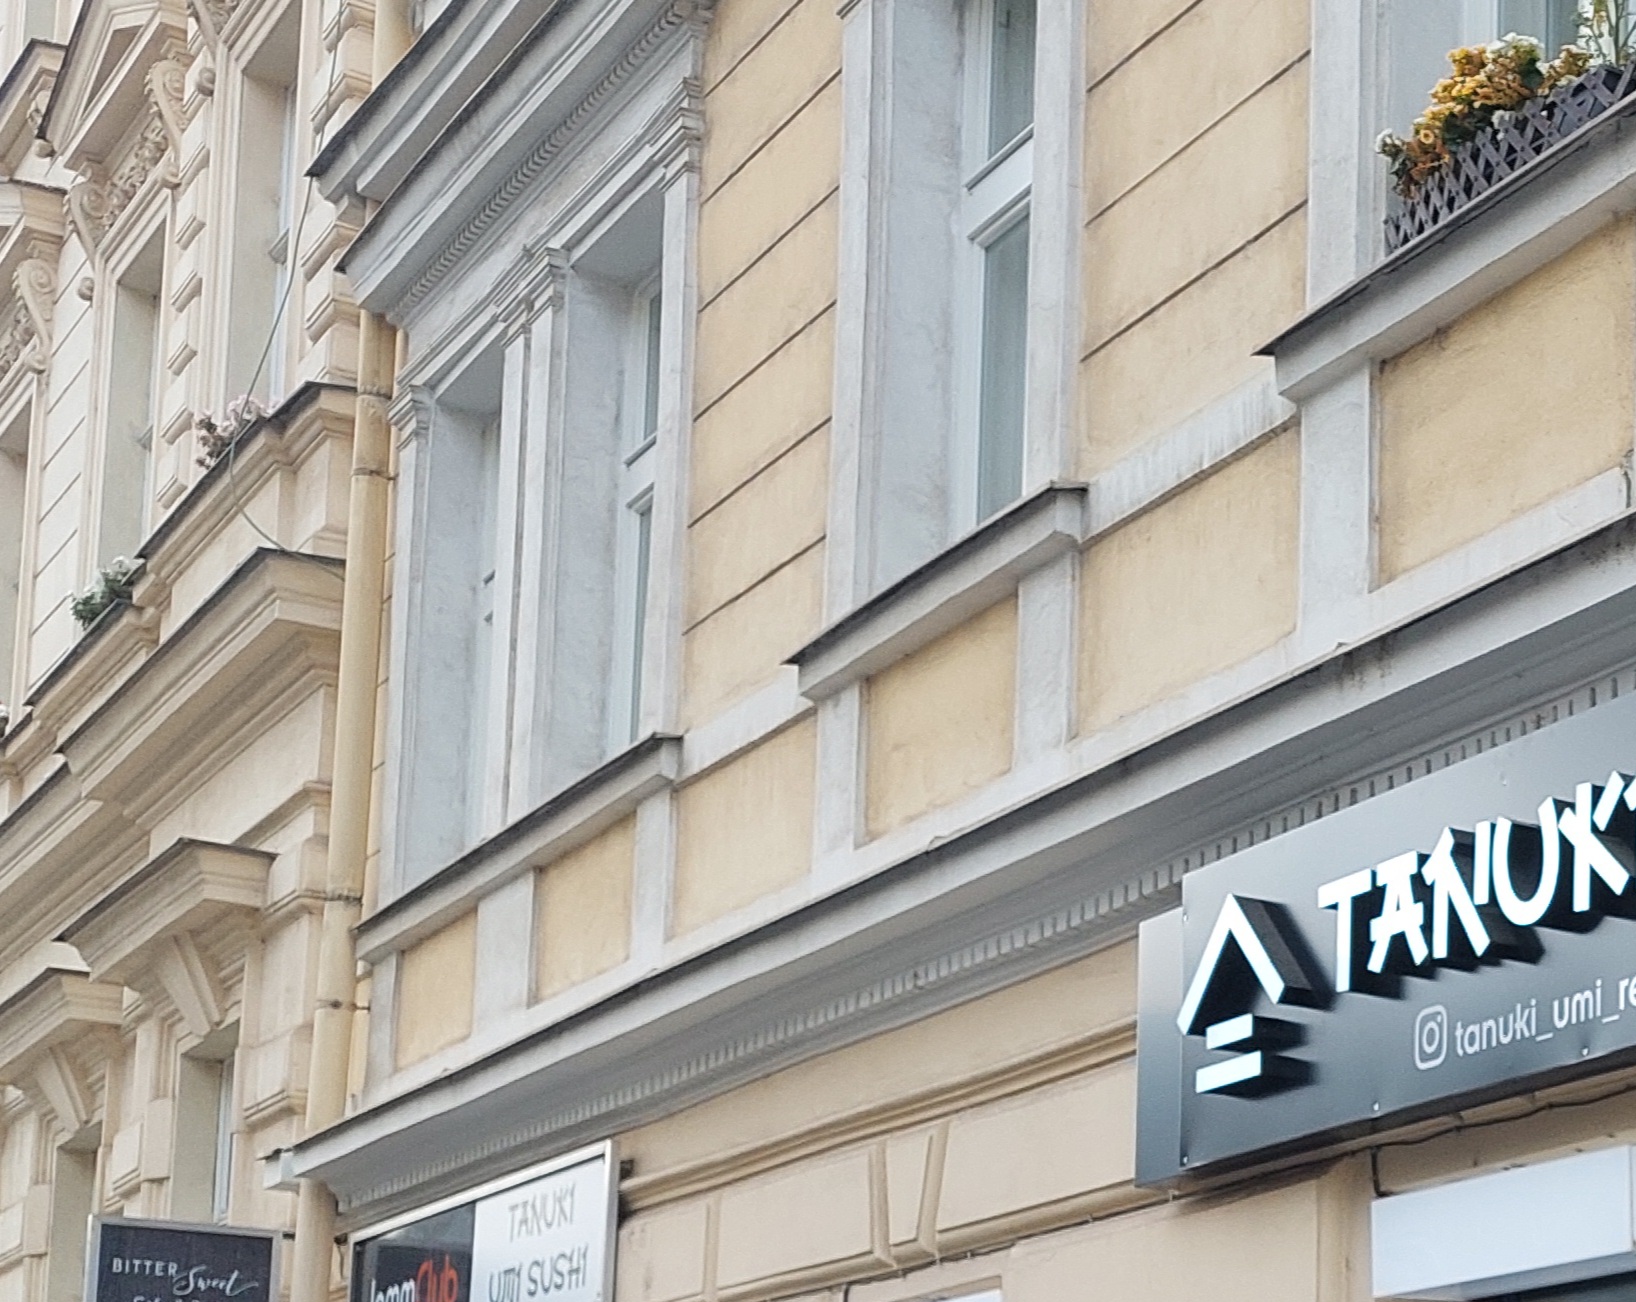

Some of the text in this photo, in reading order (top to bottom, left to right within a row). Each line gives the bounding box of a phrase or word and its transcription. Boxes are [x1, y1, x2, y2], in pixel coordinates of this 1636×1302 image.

[508, 1182, 576, 1243] TANUKI
[111, 1257, 178, 1278] BITTER
[527, 1242, 589, 1298] SUSHI
